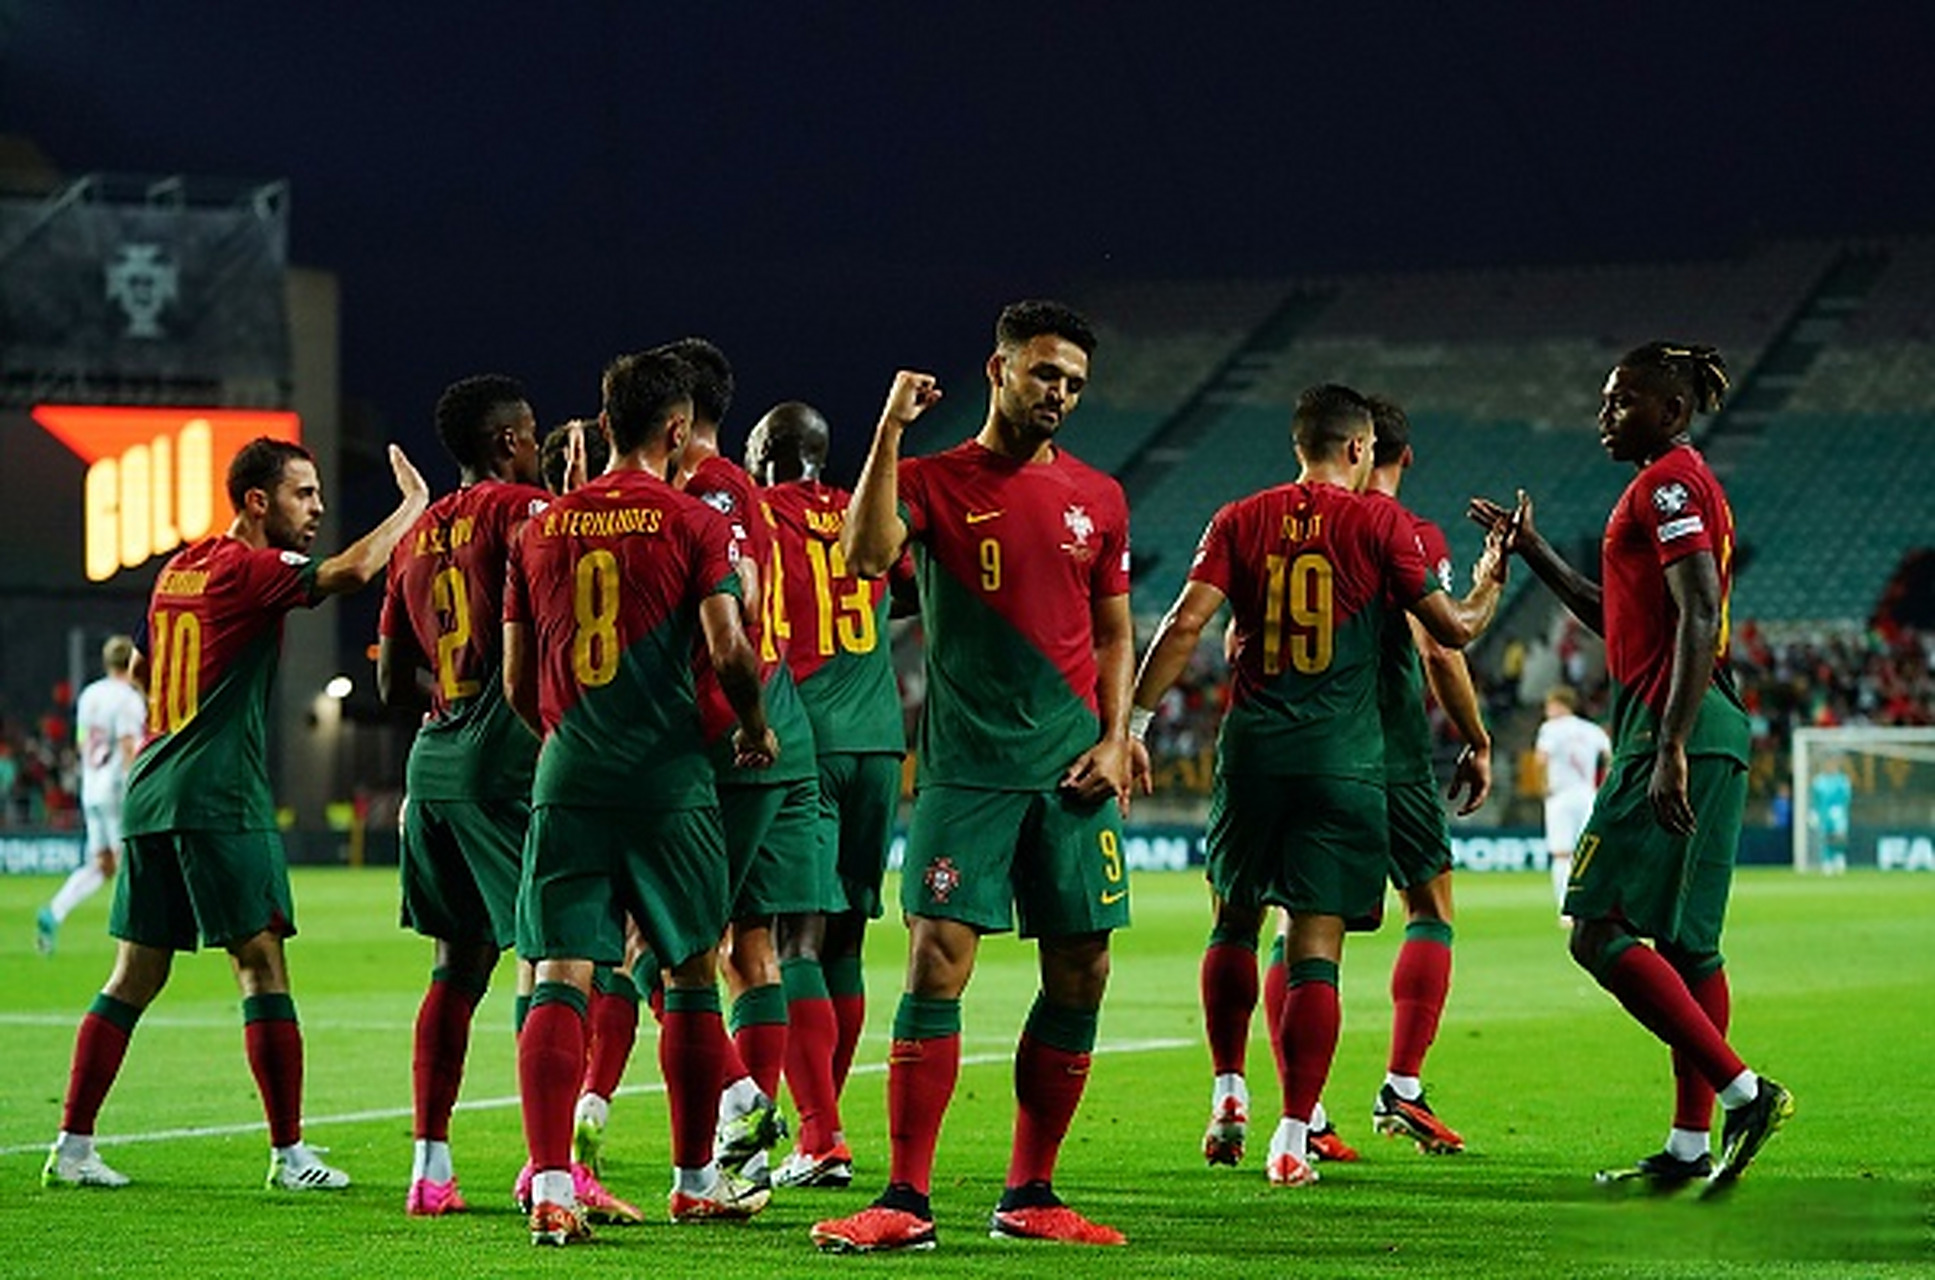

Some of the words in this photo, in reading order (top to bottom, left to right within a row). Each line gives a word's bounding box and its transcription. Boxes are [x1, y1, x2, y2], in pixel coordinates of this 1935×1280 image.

[572, 549, 620, 688] 8
[805, 538, 877, 656] 13
[979, 537, 1001, 592] 9
[1263, 553, 1333, 675] 19
[149, 610, 200, 735] 10
[433, 565, 482, 699] 2
[1100, 830, 1122, 882] 9
